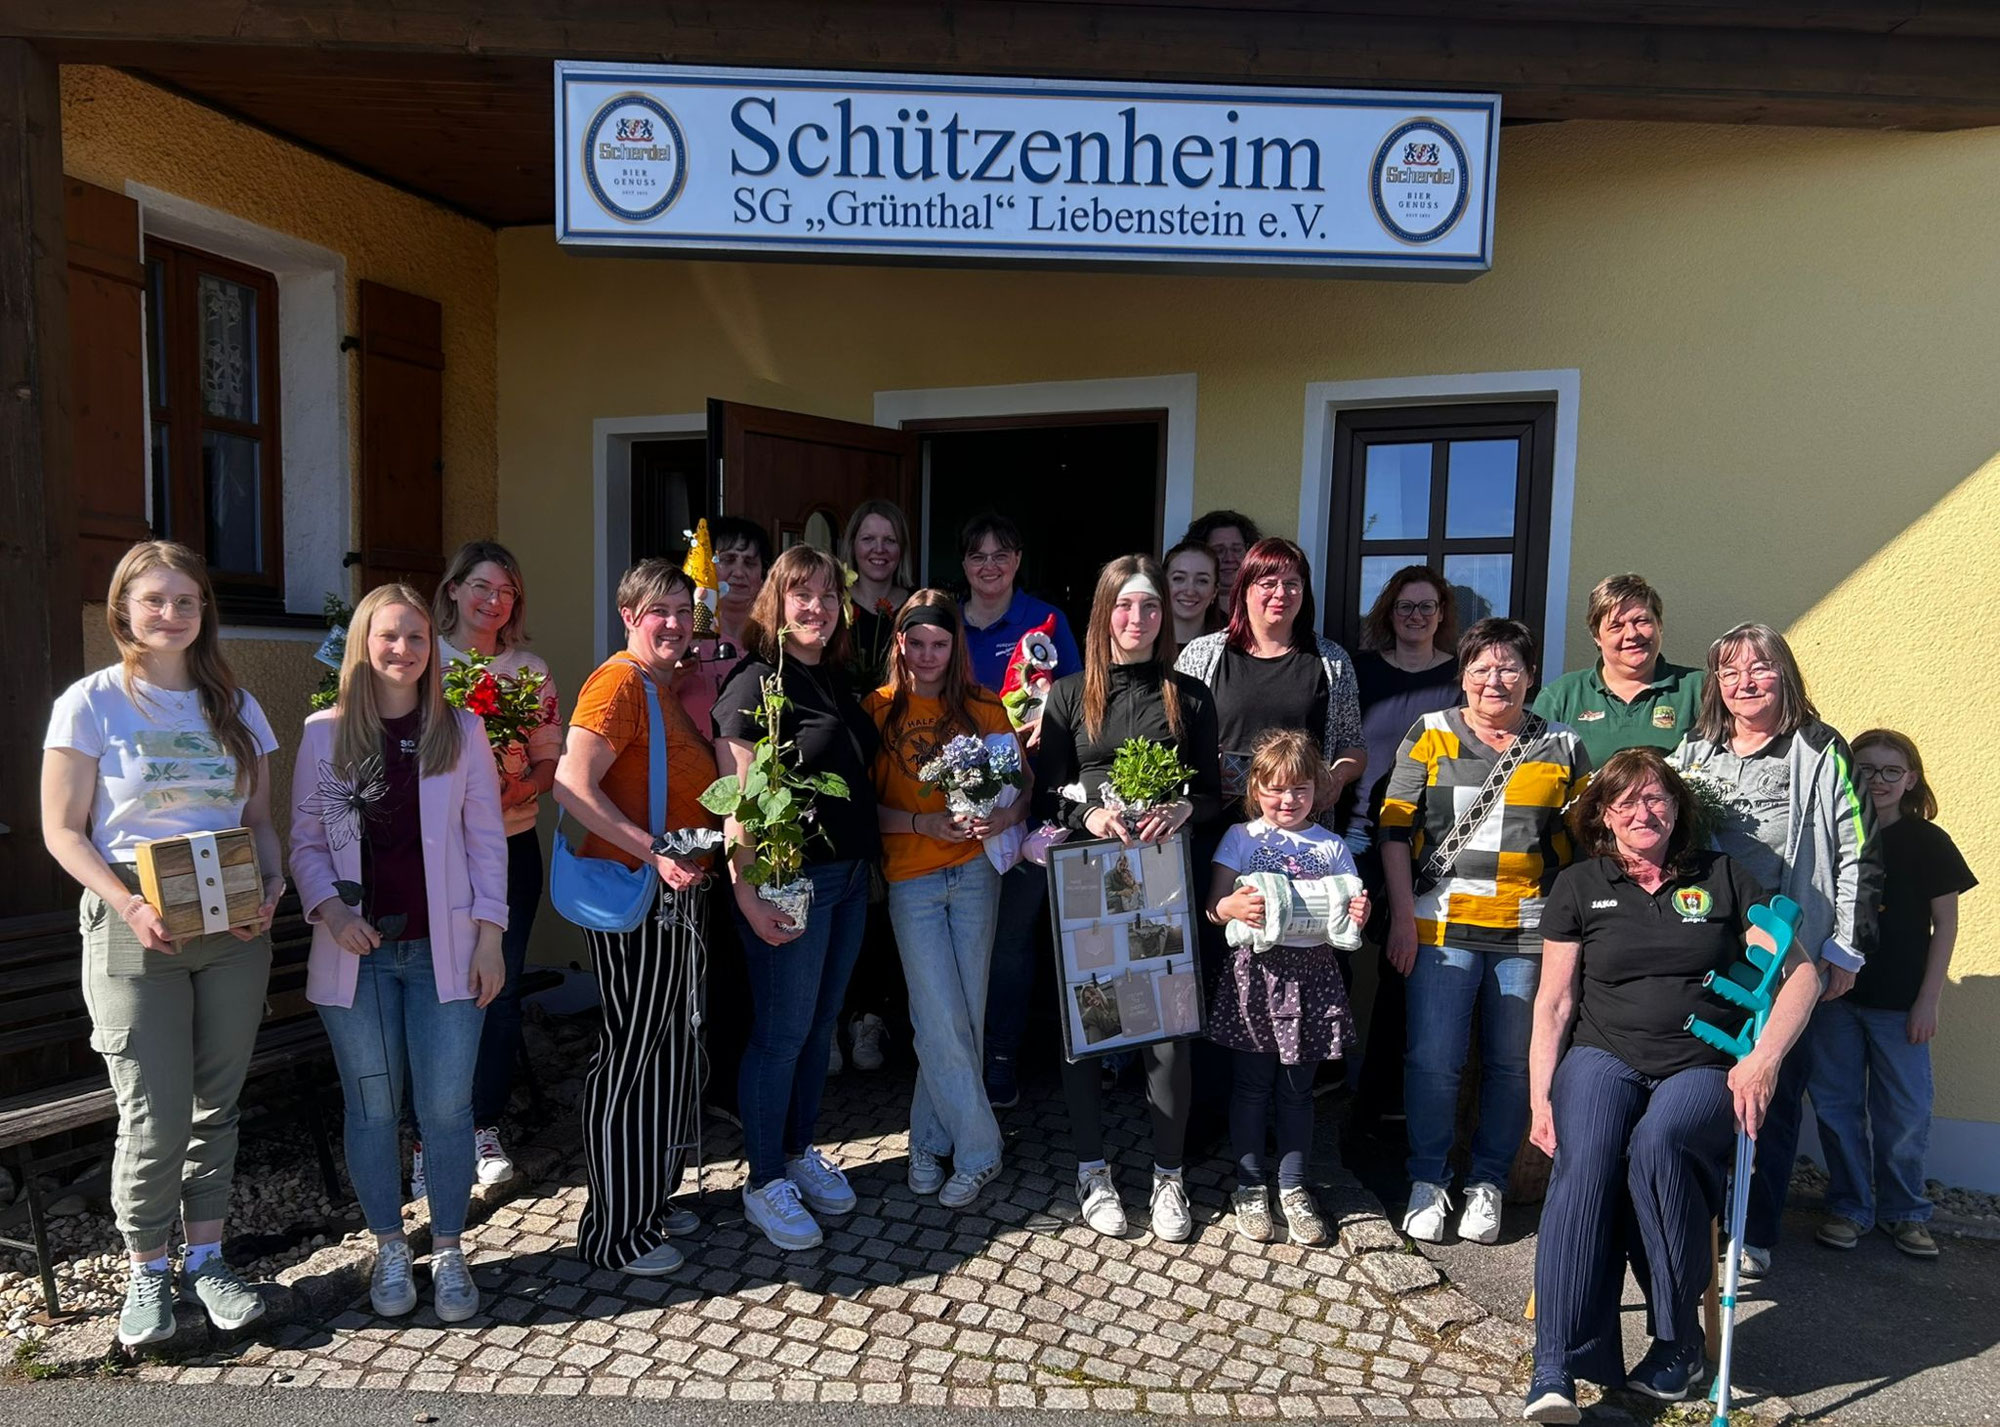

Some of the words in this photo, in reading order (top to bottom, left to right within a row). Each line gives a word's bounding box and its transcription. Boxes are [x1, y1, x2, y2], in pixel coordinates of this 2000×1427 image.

[731, 96, 1326, 192] Schützenheim
[599, 143, 671, 161] Scherdel
[622, 169, 648, 177] BIER
[1386, 167, 1455, 184] Scherdel
[614, 178, 656, 186] GENUSS
[1407, 192, 1431, 200] BIER
[1398, 201, 1439, 209] GENUSS
[733, 187, 793, 225] SG
[805, 190, 1016, 232] „Grünthal“
[1028, 196, 1246, 237] Liebenstein
[1591, 899, 1618, 909] JAKO
